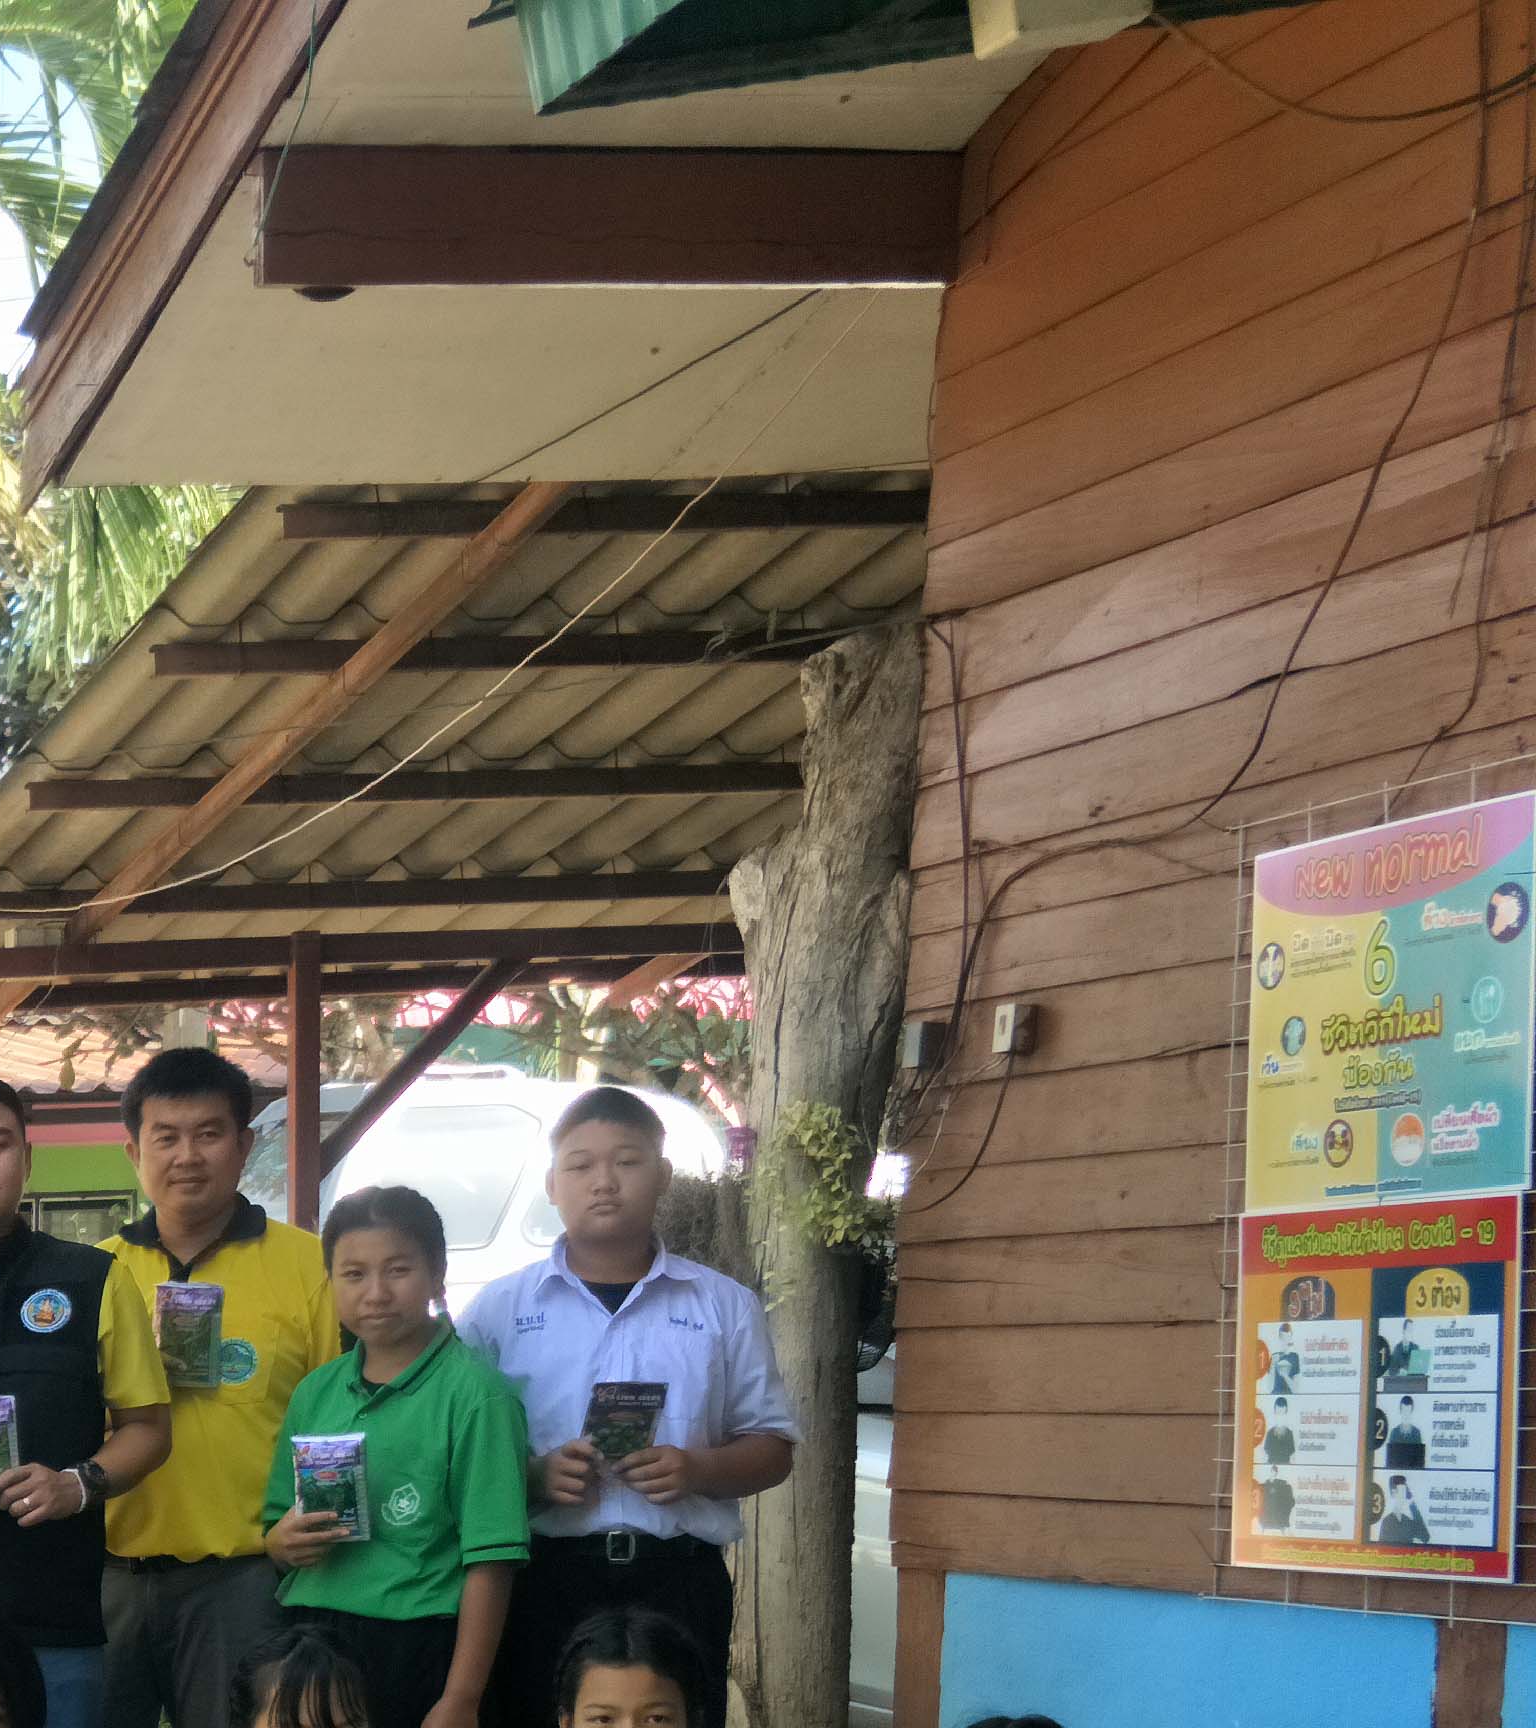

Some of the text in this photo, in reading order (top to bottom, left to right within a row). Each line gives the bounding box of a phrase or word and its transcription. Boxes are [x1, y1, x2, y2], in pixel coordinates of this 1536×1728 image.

[1364, 813, 1484, 897] normal
[1364, 918, 1396, 997] 6
[1408, 1215, 1457, 1248] Covid
[1477, 1219, 1496, 1246] 19
